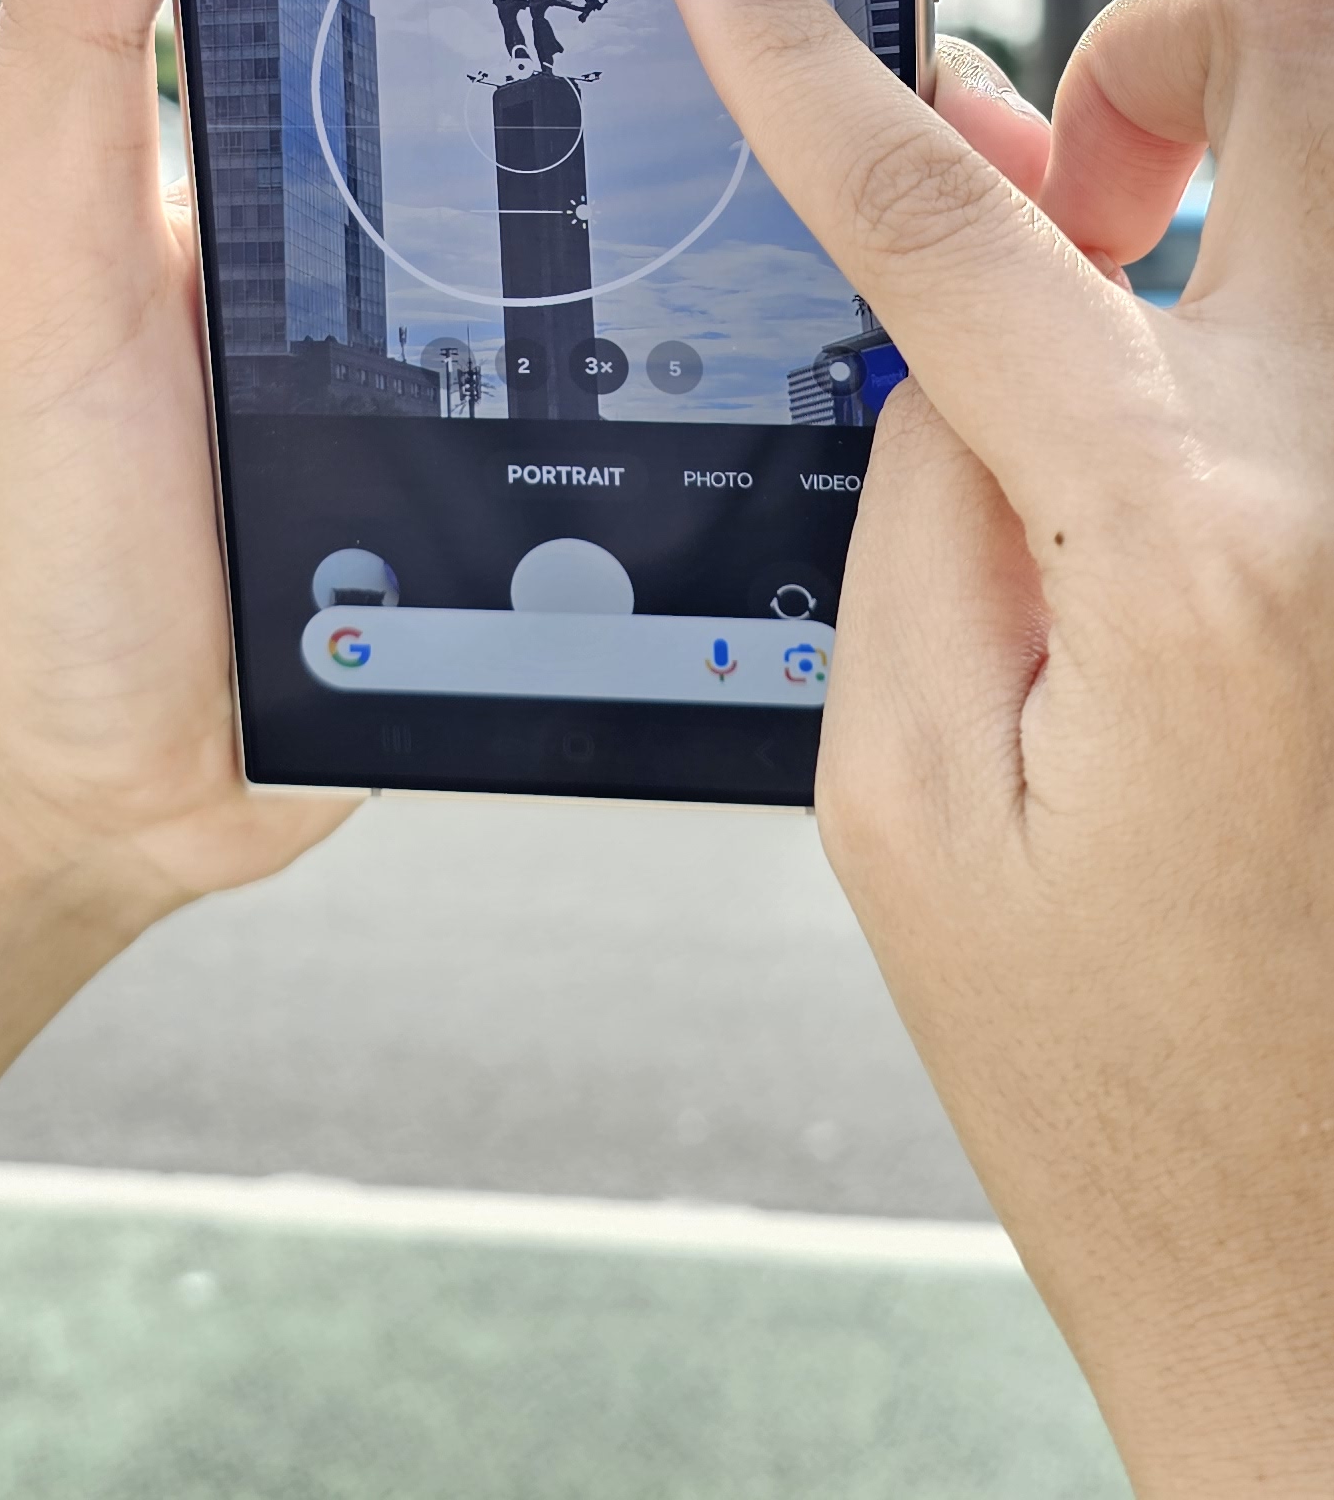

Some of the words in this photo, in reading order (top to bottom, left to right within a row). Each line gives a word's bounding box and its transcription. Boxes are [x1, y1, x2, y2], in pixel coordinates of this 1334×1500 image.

[517, 357, 531, 374] 2
[668, 361, 682, 377] 5
[507, 465, 625, 487] PORTRAIT
[683, 470, 753, 489] PHOTO
[799, 473, 861, 492] VIDEO
